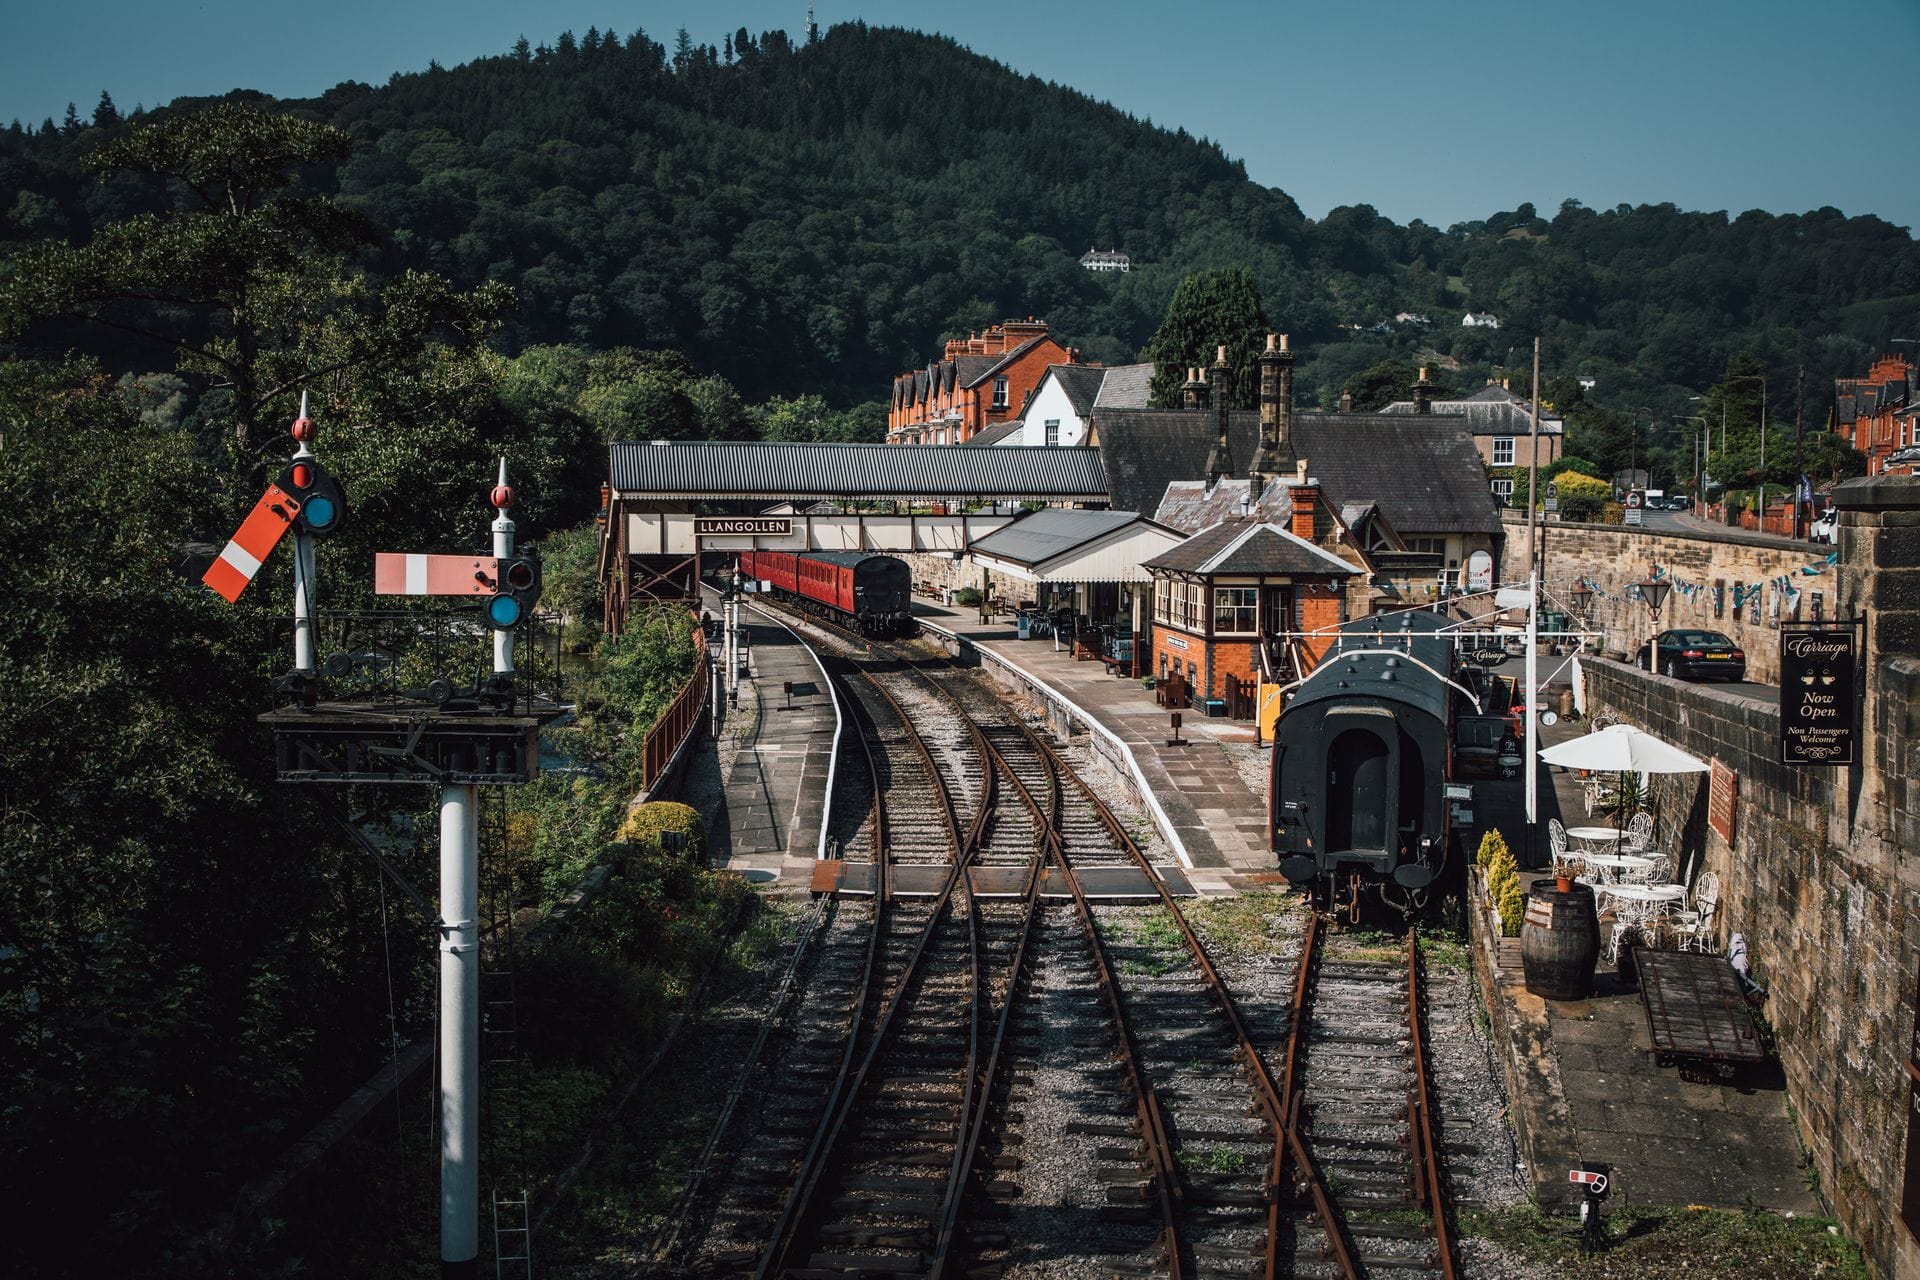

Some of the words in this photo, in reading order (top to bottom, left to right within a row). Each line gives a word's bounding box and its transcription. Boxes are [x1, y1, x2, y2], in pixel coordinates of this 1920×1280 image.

[701, 521, 785, 532] LLANGOLLEN
[1787, 637, 1848, 661] Carriage
[1472, 649, 1506, 664] Carriage
[1802, 692, 1834, 704] Now
[1800, 705, 1837, 720] Open
[1787, 726, 1805, 735] Non
[1808, 726, 1849, 737] Passengers
[1799, 735, 1837, 743] Welcome
